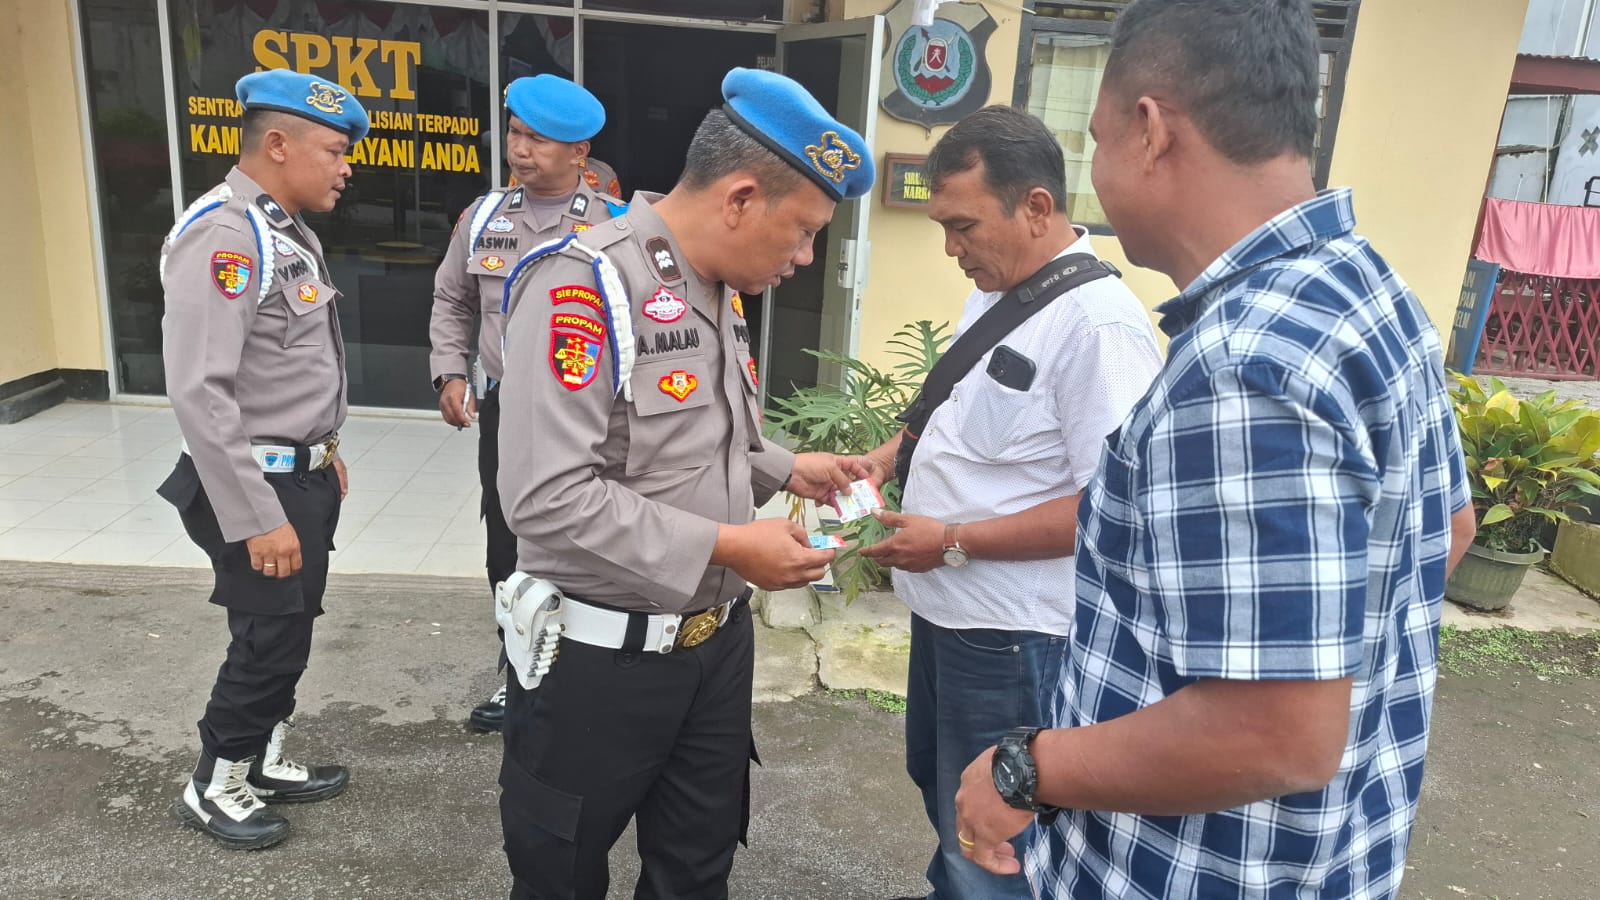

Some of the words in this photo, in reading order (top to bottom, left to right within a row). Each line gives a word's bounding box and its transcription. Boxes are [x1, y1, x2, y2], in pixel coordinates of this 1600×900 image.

[253, 29, 421, 100] SPKT
[188, 96, 243, 117] SENTRA
[367, 110, 413, 131] LISIAN
[416, 114, 479, 136] TERPADU
[421, 142, 480, 173] ANDA
[478, 237, 518, 249] ASWIN
[216, 253, 250, 265] PROPAM
[555, 316, 603, 335] PROPAM
